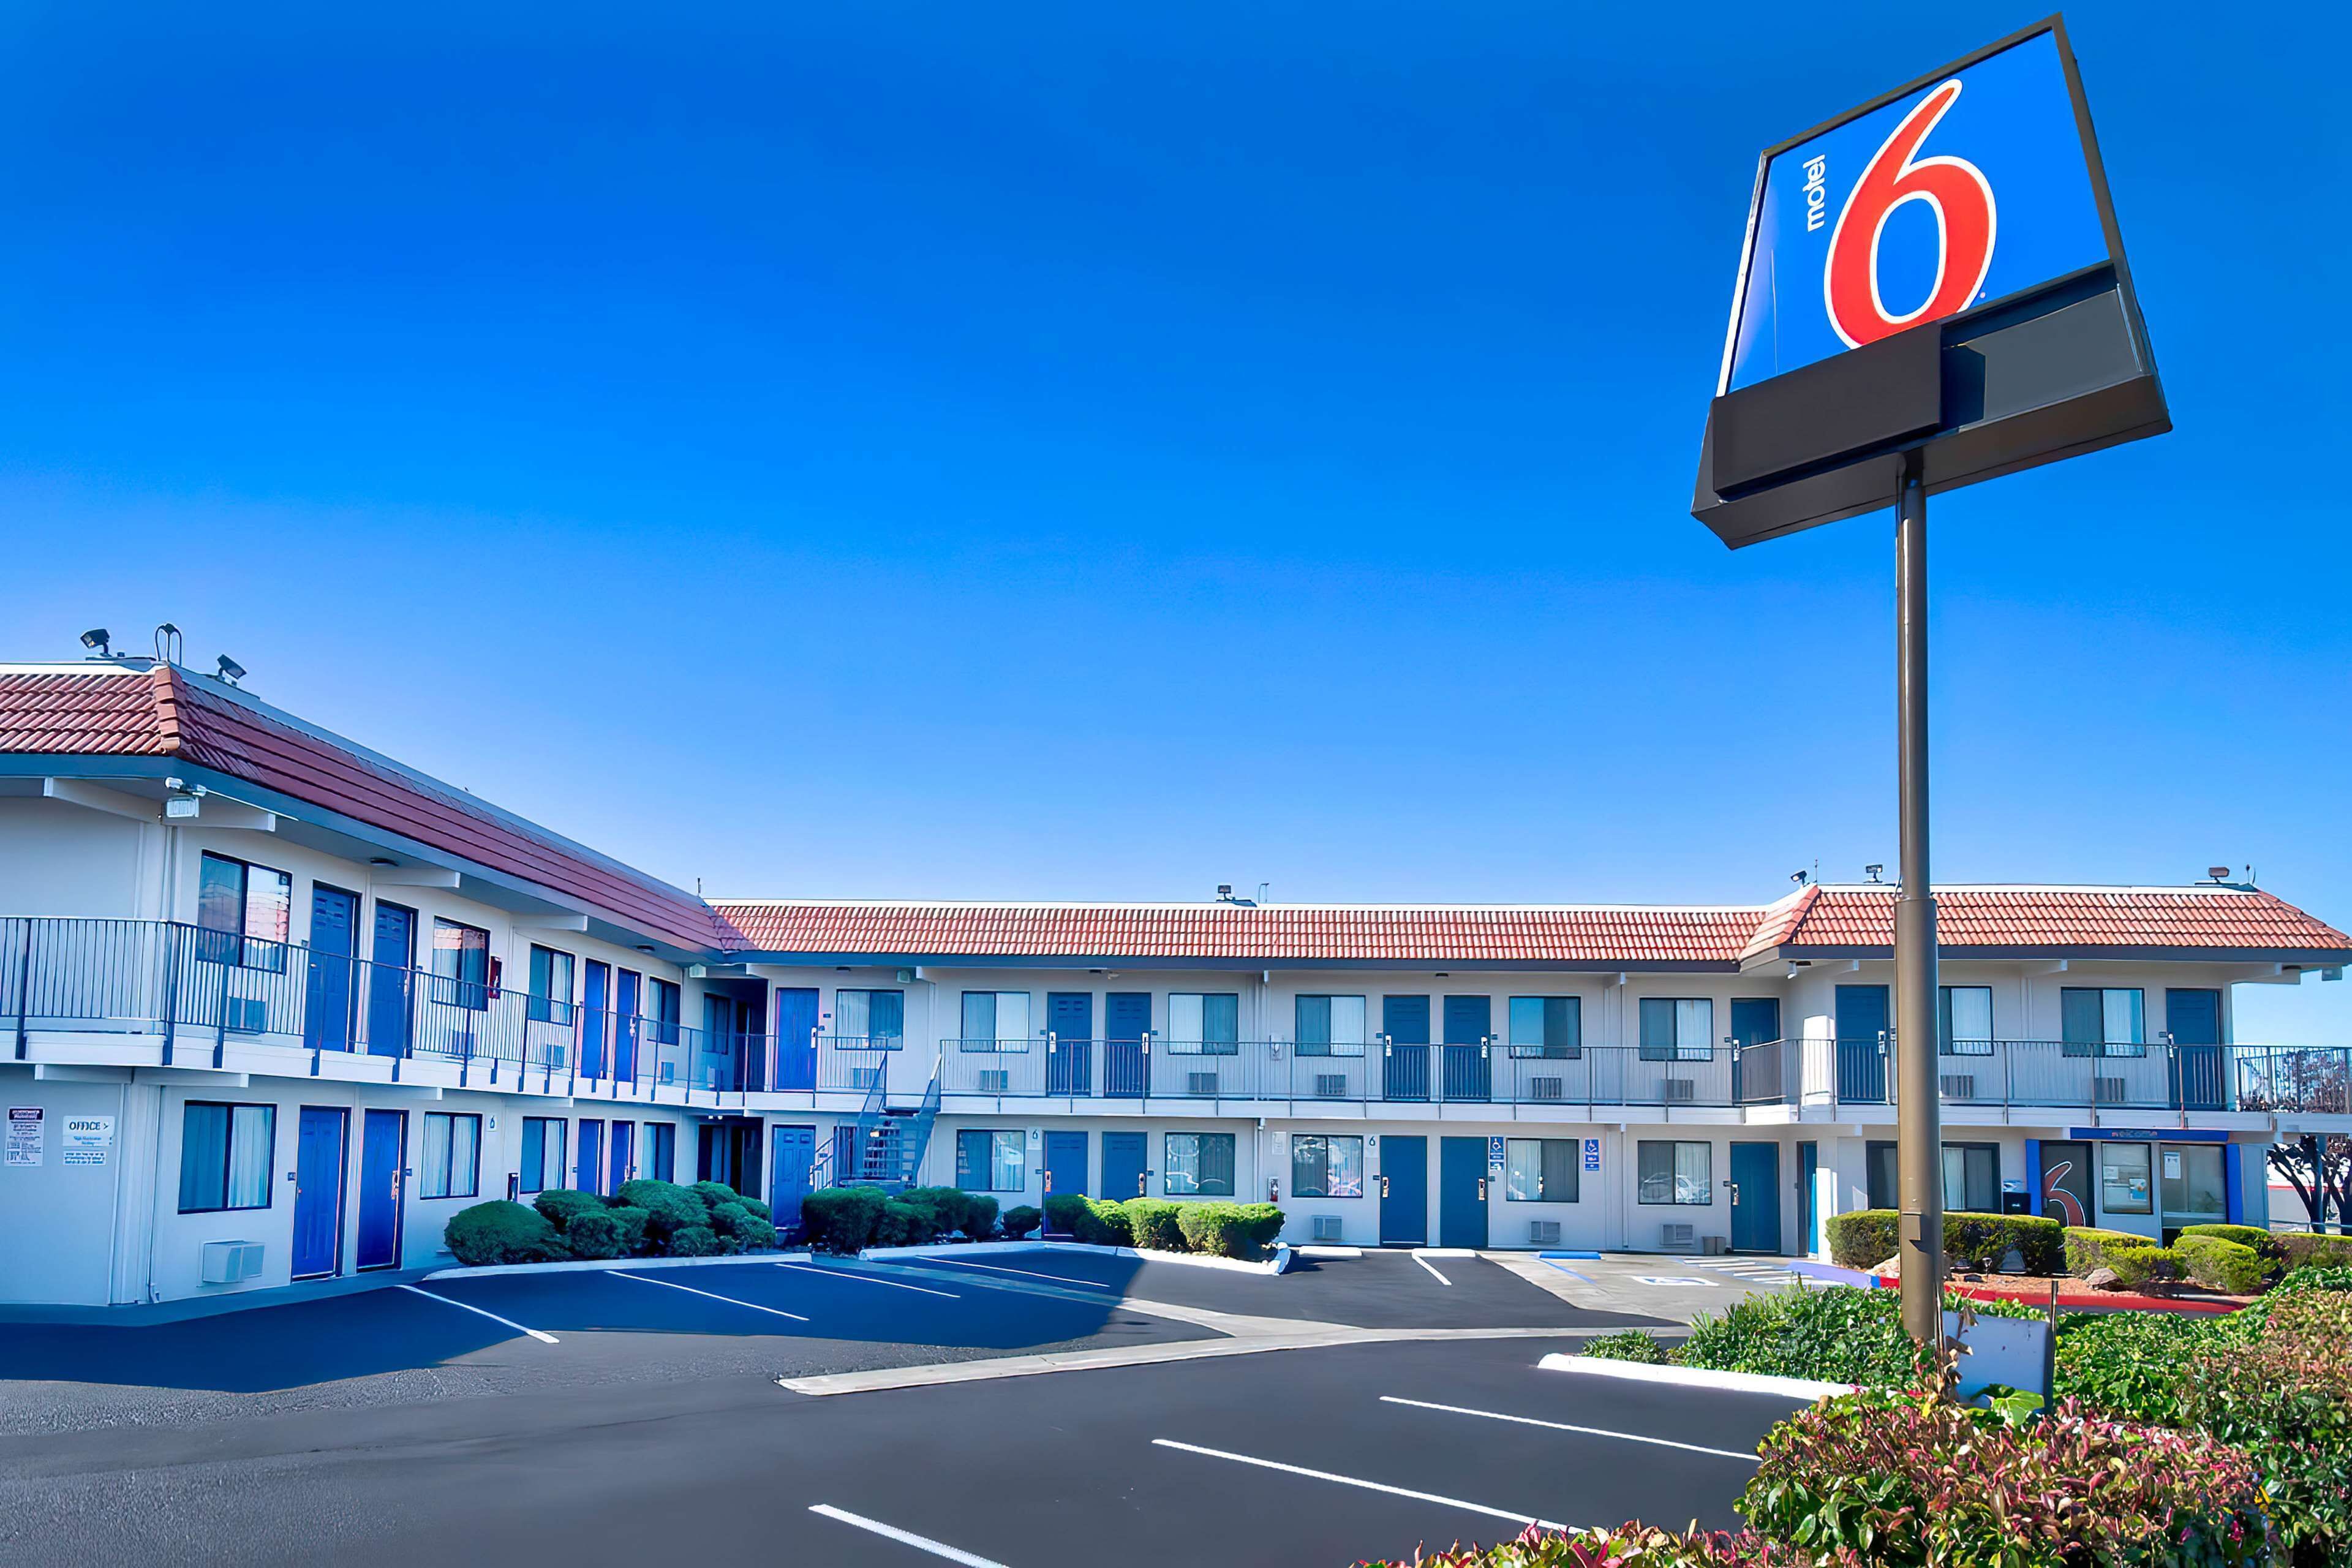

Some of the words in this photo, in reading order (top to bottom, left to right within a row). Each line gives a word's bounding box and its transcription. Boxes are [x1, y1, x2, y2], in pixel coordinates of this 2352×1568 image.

[1803, 154, 1825, 232] motel
[1824, 78, 1997, 350] 6
[69, 1121, 100, 1131] OFFICE
[1369, 1136, 1376, 1146] 6
